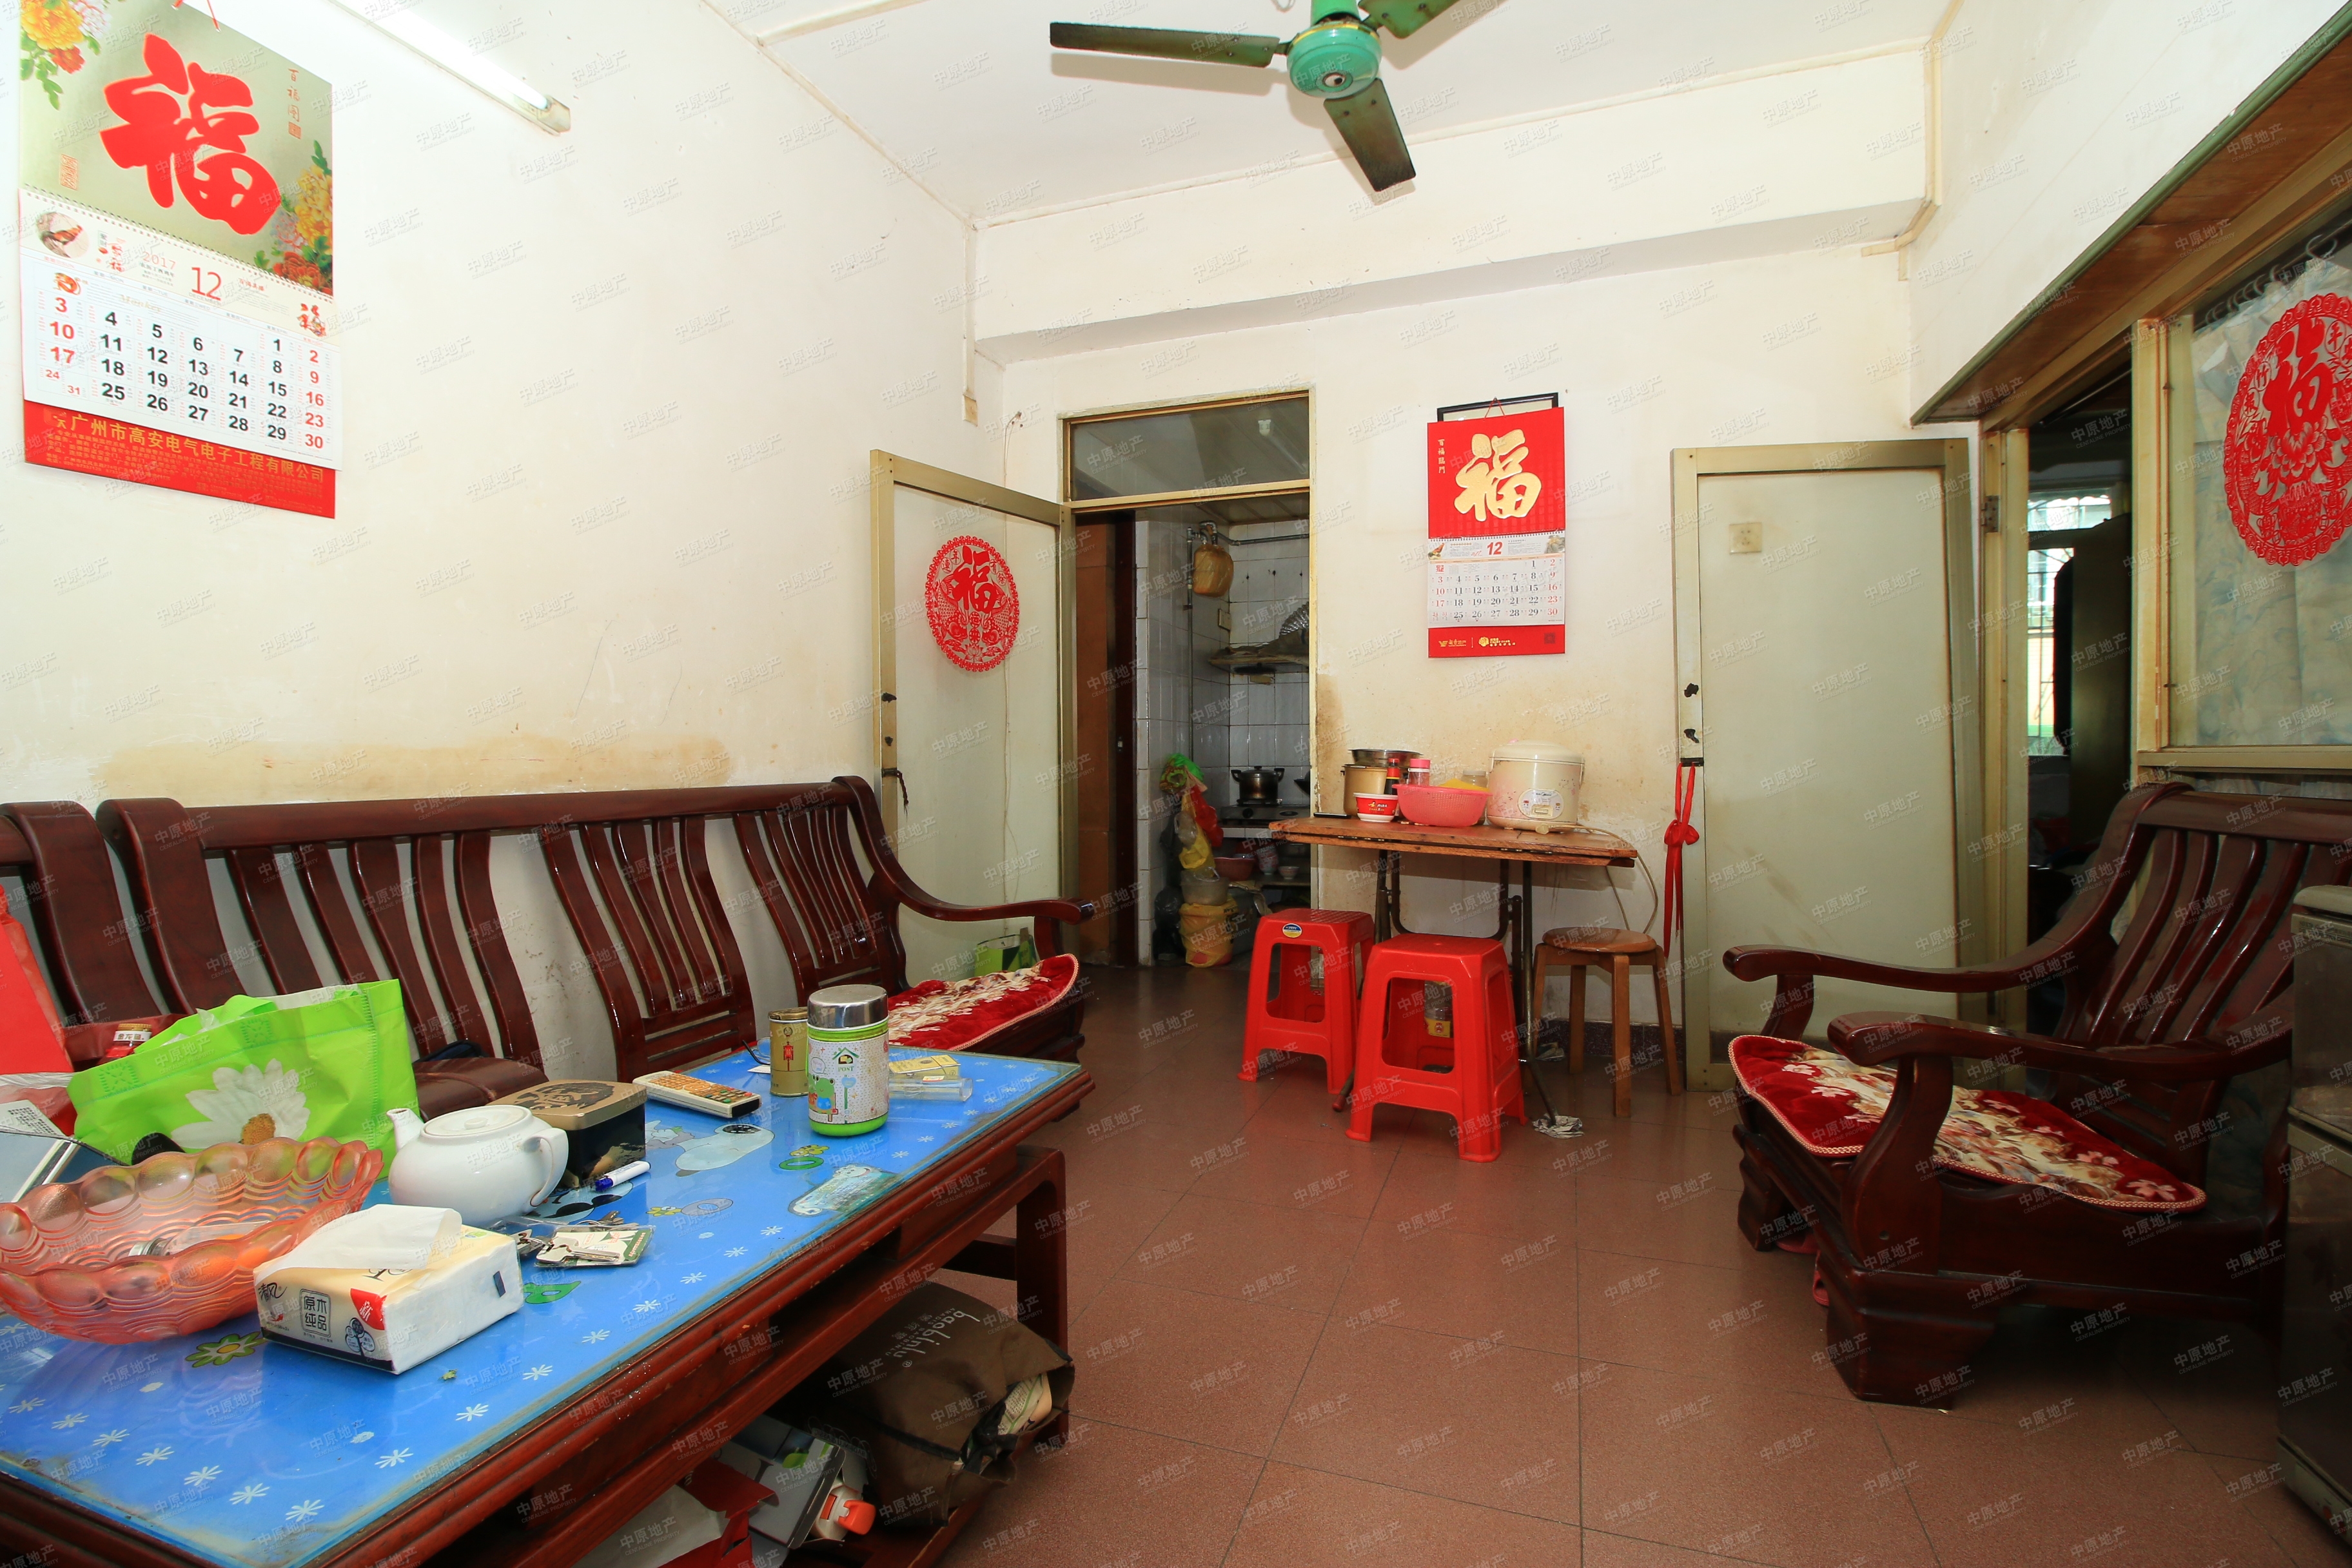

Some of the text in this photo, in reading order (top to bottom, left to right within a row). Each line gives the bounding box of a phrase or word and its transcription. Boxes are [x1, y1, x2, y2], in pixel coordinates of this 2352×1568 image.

[99, 33, 281, 235] 福
[142, 251, 176, 270] 2017
[191, 267, 222, 301] 12
[50, 321, 324, 406] 10 11 12 13 14 15 16
[55, 297, 319, 384] 3 4 5 6 7 8 9
[273, 338, 318, 363] 1 2
[45, 369, 323, 449] 24 25 26 27 28 29 30
[50, 346, 324, 427] 17 18 19 20 21 22 23
[67, 385, 80, 395] 31
[2262, 316, 2333, 438] 福
[70, 414, 323, 483] 广州市高安电气电子工程有限公司
[1454, 429, 1542, 522] 福
[952, 545, 990, 614] 福
[1487, 542, 1503, 555] 12
[304, 1296, 328, 1314] 原木
[305, 1313, 328, 1331] 纯品
[893, 1311, 980, 1357] baobinlu
